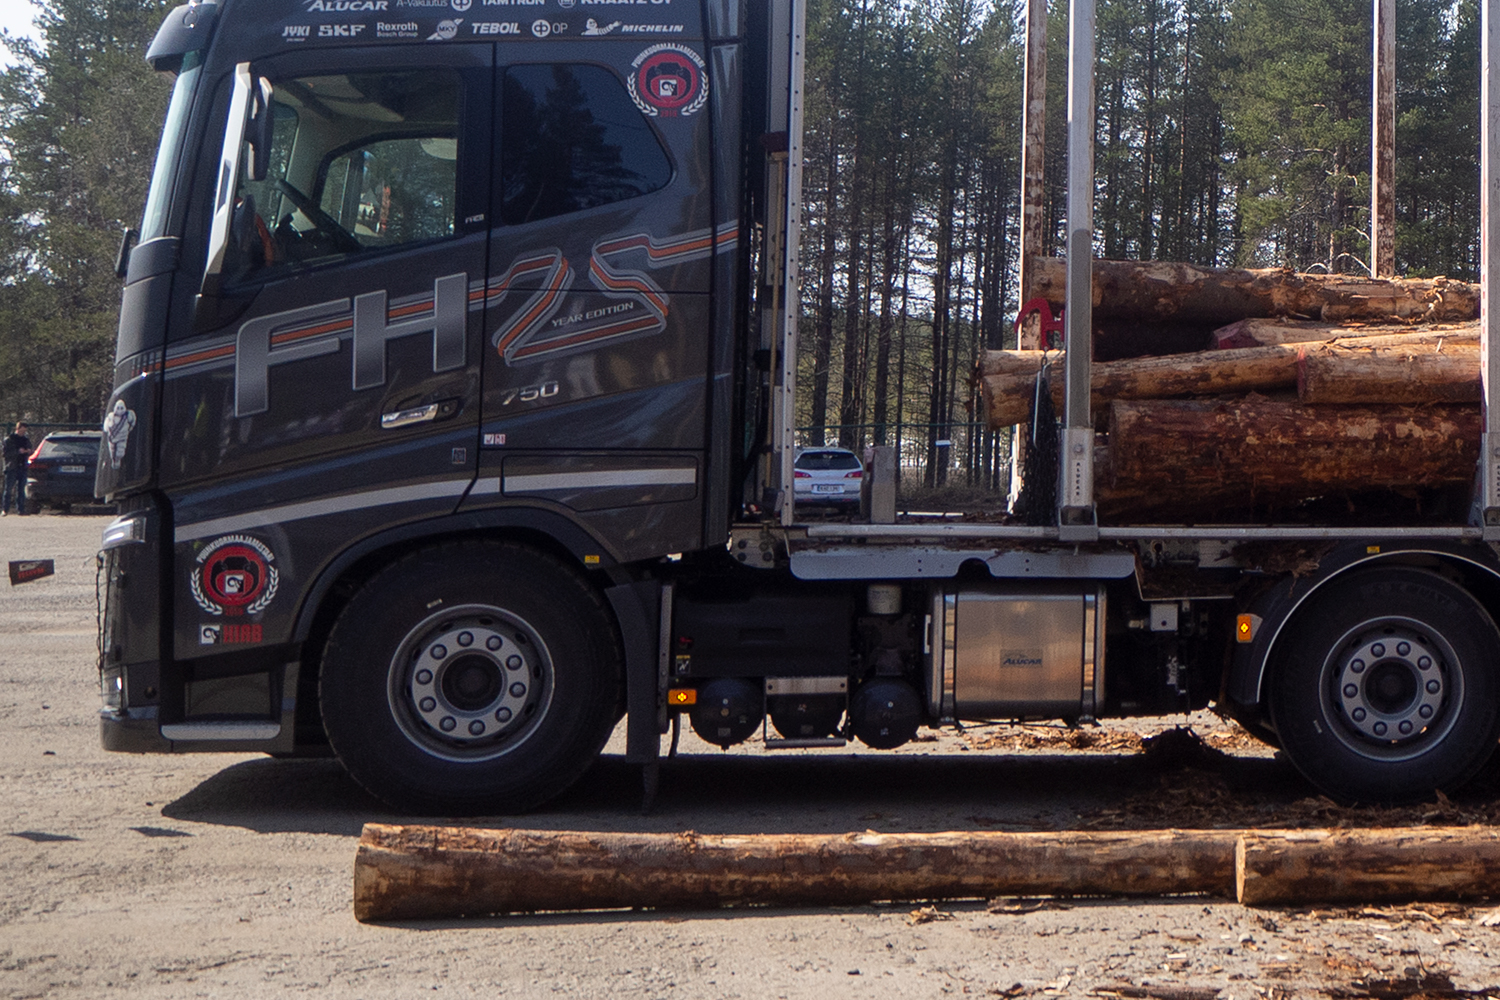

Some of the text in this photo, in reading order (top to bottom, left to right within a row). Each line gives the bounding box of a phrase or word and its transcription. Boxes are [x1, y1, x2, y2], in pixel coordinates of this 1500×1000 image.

[307, 0, 389, 12] ALUCAR
[318, 24, 366, 37] SKF
[376, 22, 418, 31] Rexroth
[471, 23, 521, 34] TEBOIL
[552, 23, 568, 34] OP
[552, 301, 635, 328] YEAR EDITION
[234, 233, 670, 418] FH 25
[500, 380, 559, 406] 750
[223, 624, 263, 643] HIAB
